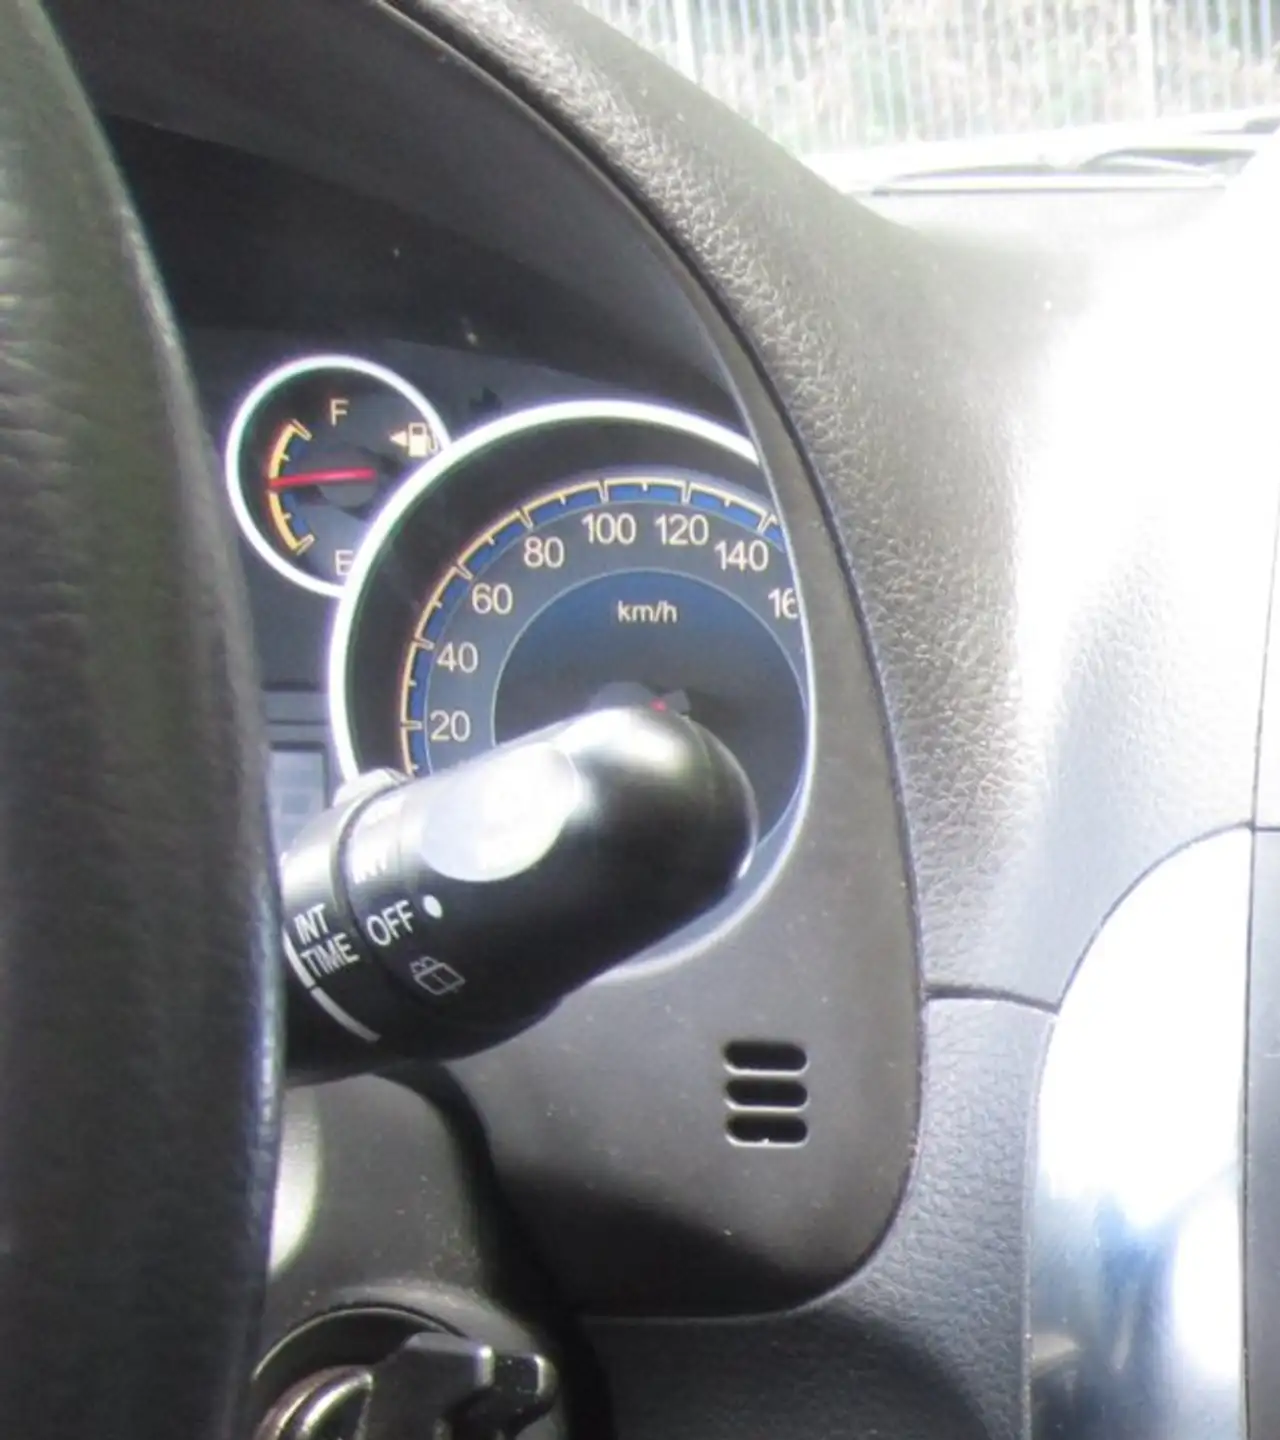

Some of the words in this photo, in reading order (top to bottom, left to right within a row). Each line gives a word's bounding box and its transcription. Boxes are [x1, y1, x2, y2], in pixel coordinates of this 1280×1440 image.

[330, 399, 348, 425] F
[581, 514, 636, 544] 100
[655, 514, 709, 545] 120
[335, 550, 353, 575] E
[523, 537, 564, 568] 80
[714, 540, 769, 571] 140
[472, 583, 513, 614] 60
[617, 600, 677, 624] km/h
[437, 642, 478, 671] 40
[430, 711, 471, 741] 20
[294, 903, 328, 945] INT
[366, 900, 413, 946] OFF
[301, 932, 360, 977] TIME
